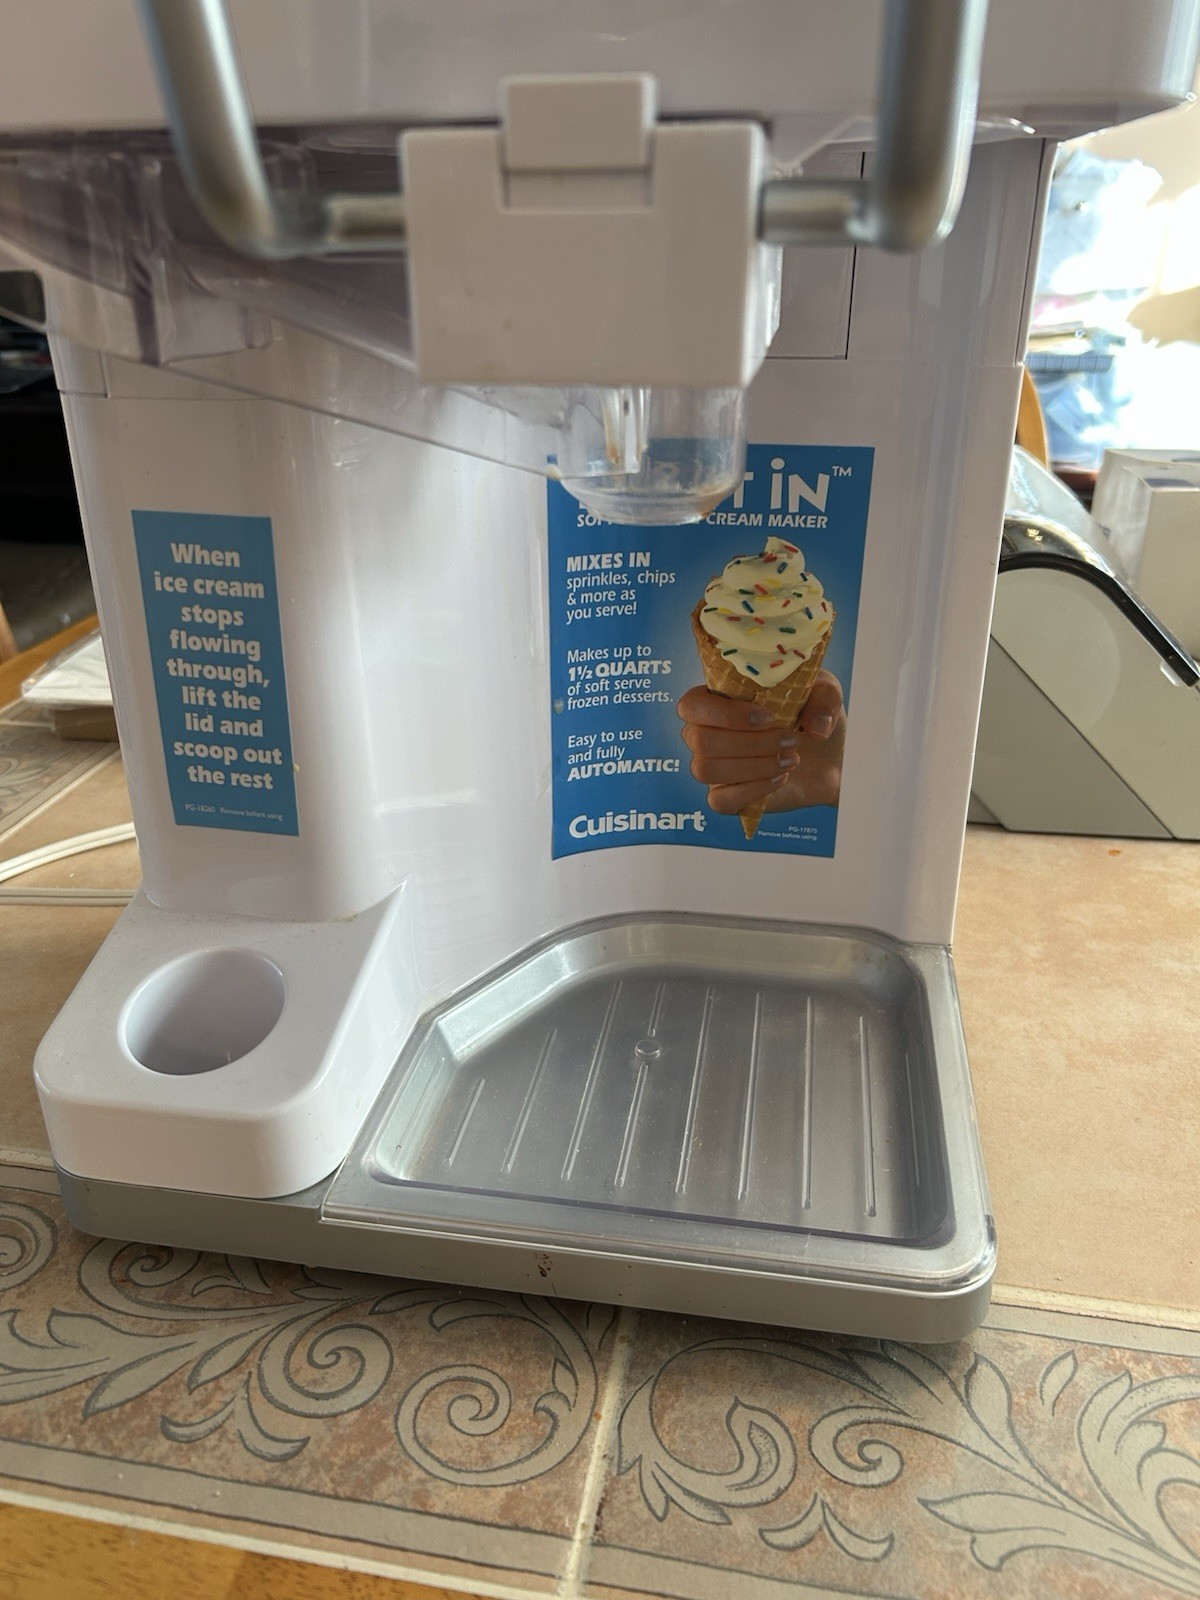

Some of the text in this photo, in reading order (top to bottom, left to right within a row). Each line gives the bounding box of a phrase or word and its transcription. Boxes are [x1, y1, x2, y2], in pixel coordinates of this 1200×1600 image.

[706, 512, 763, 527] CREAM
[768, 514, 828, 529] MAKER
[170, 543, 240, 567] When
[566, 552, 651, 572] MIXES IN
[154, 571, 265, 599] ice cream
[566, 569, 676, 592] sprinkles, chips
[567, 589, 636, 606] & more as
[181, 605, 244, 631] stops
[566, 602, 637, 625] you serve!
[170, 629, 262, 662] flowing
[567, 645, 651, 663] Makes up to
[166, 658, 270, 688] through,
[595, 660, 672, 678] QUARTS
[181, 685, 262, 710] lift the
[567, 678, 651, 697] of soft serve
[567, 690, 674, 711] frozen desserts.
[185, 712, 264, 737] lid and
[568, 729, 643, 748] Easy to use
[173, 741, 282, 766] scoop out
[567, 745, 625, 765] and fully
[187, 766, 273, 790] the rest
[567, 759, 680, 782] AUTOMATIC!
[220, 806, 245, 816] Remove
[245, 810, 266, 818] before
[267, 813, 283, 821] using
[569, 809, 705, 839] Cuisinart
[758, 830, 781, 838] Remove
